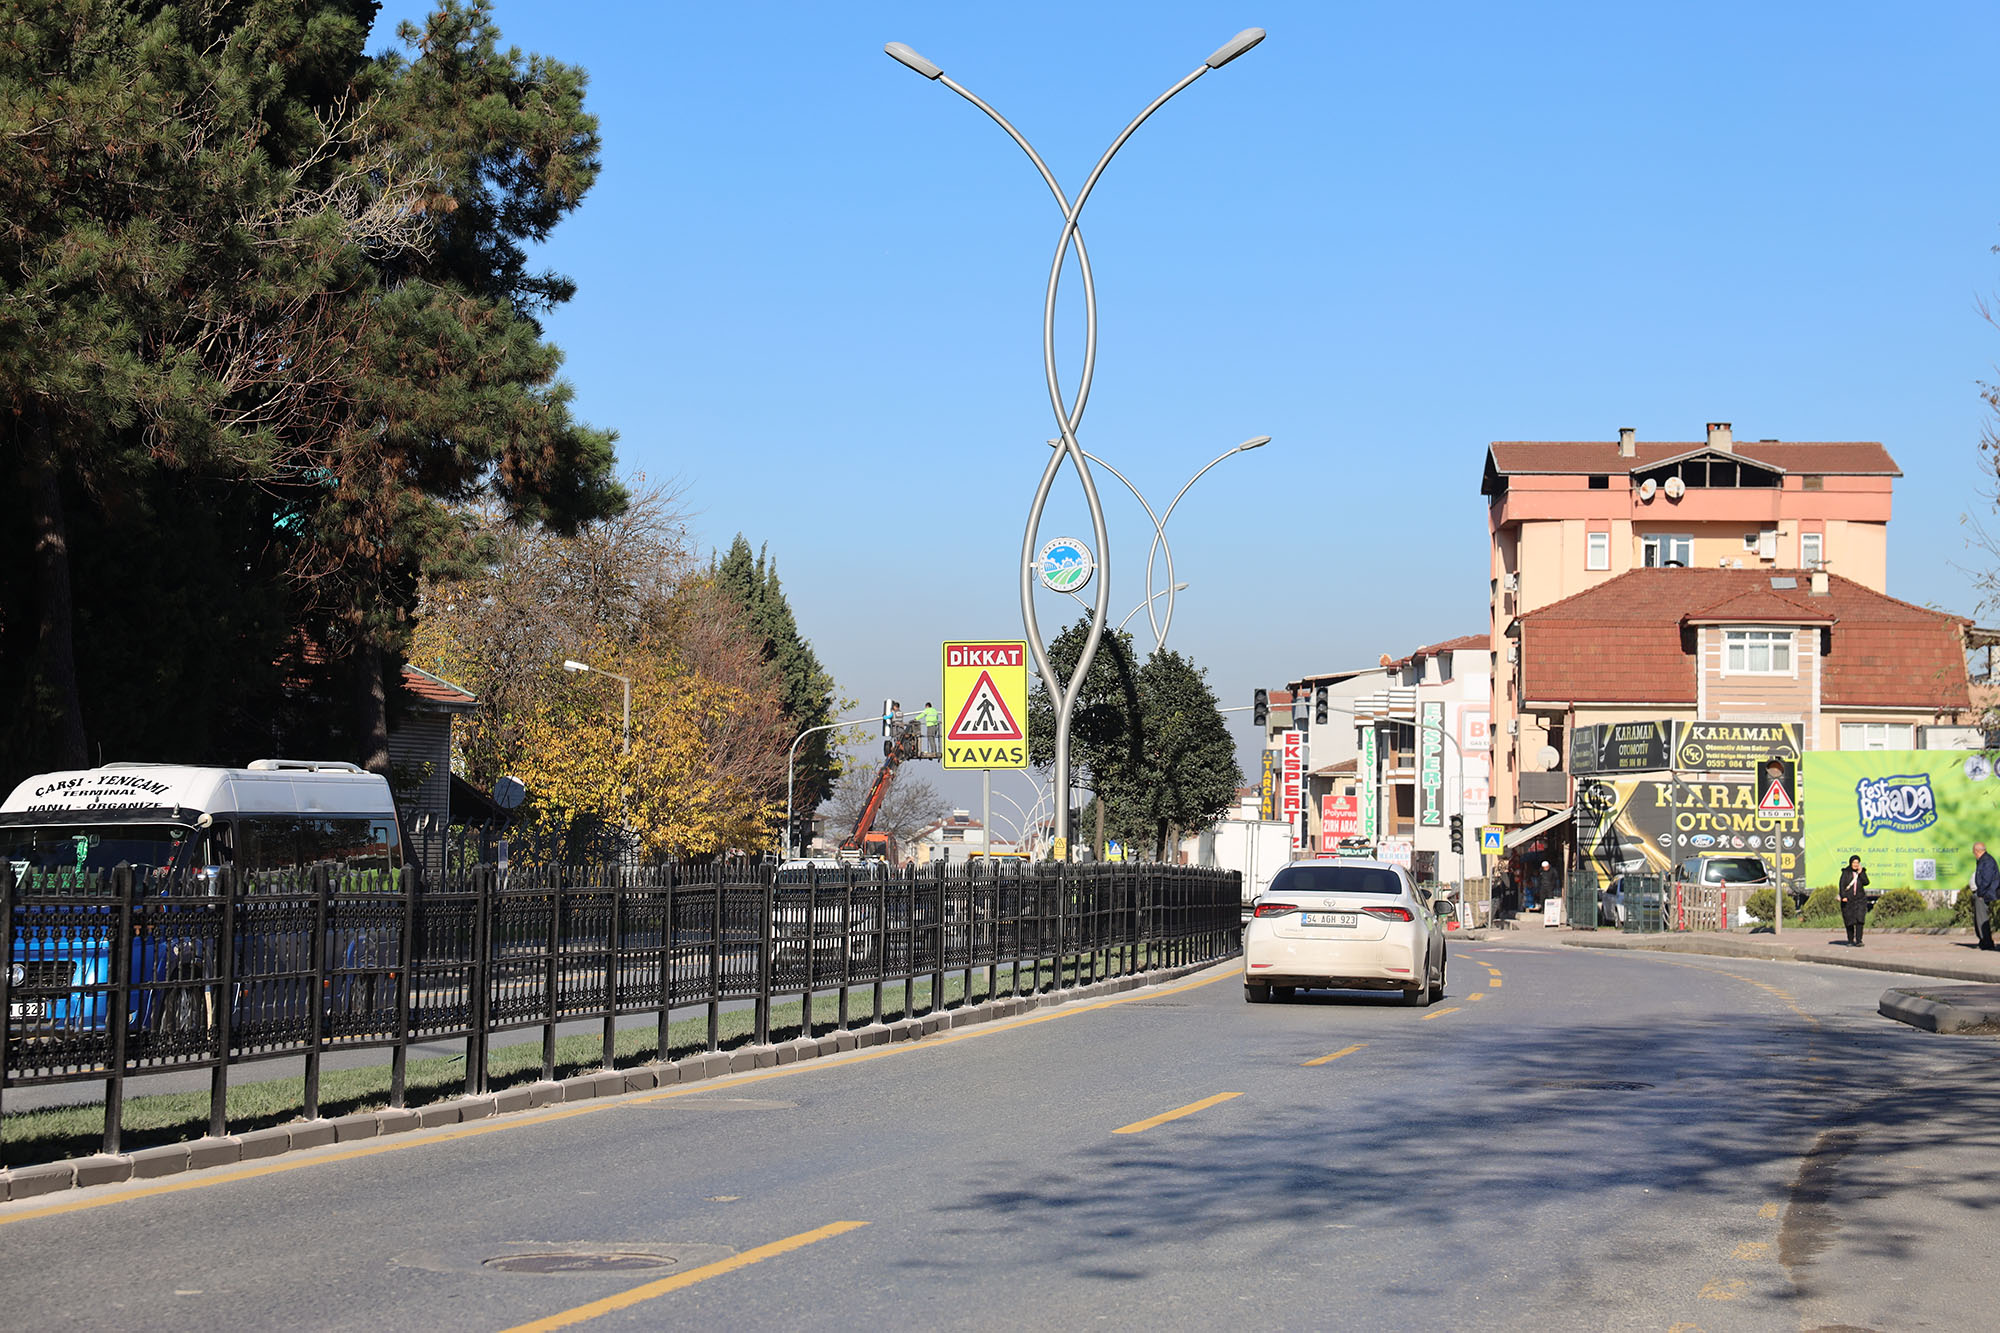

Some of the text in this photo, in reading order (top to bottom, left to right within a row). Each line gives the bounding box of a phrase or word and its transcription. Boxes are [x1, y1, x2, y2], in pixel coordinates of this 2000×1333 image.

[950, 646, 1020, 666] DİKKAT
[1615, 725, 1654, 741] KARAMAN
[1692, 727, 1783, 741] KARAMAN
[948, 747, 1023, 764] YAVAŞ
[1618, 741, 1648, 756] OTOMOTİV
[35, 778, 84, 797] ÇARŞI
[98, 775, 173, 796] YENİCAMİ
[62, 788, 137, 797] TERMİNAL
[1324, 808, 1357, 818] Polyurea
[1321, 915, 1336, 923] AGH
[1341, 916, 1355, 924] 923
